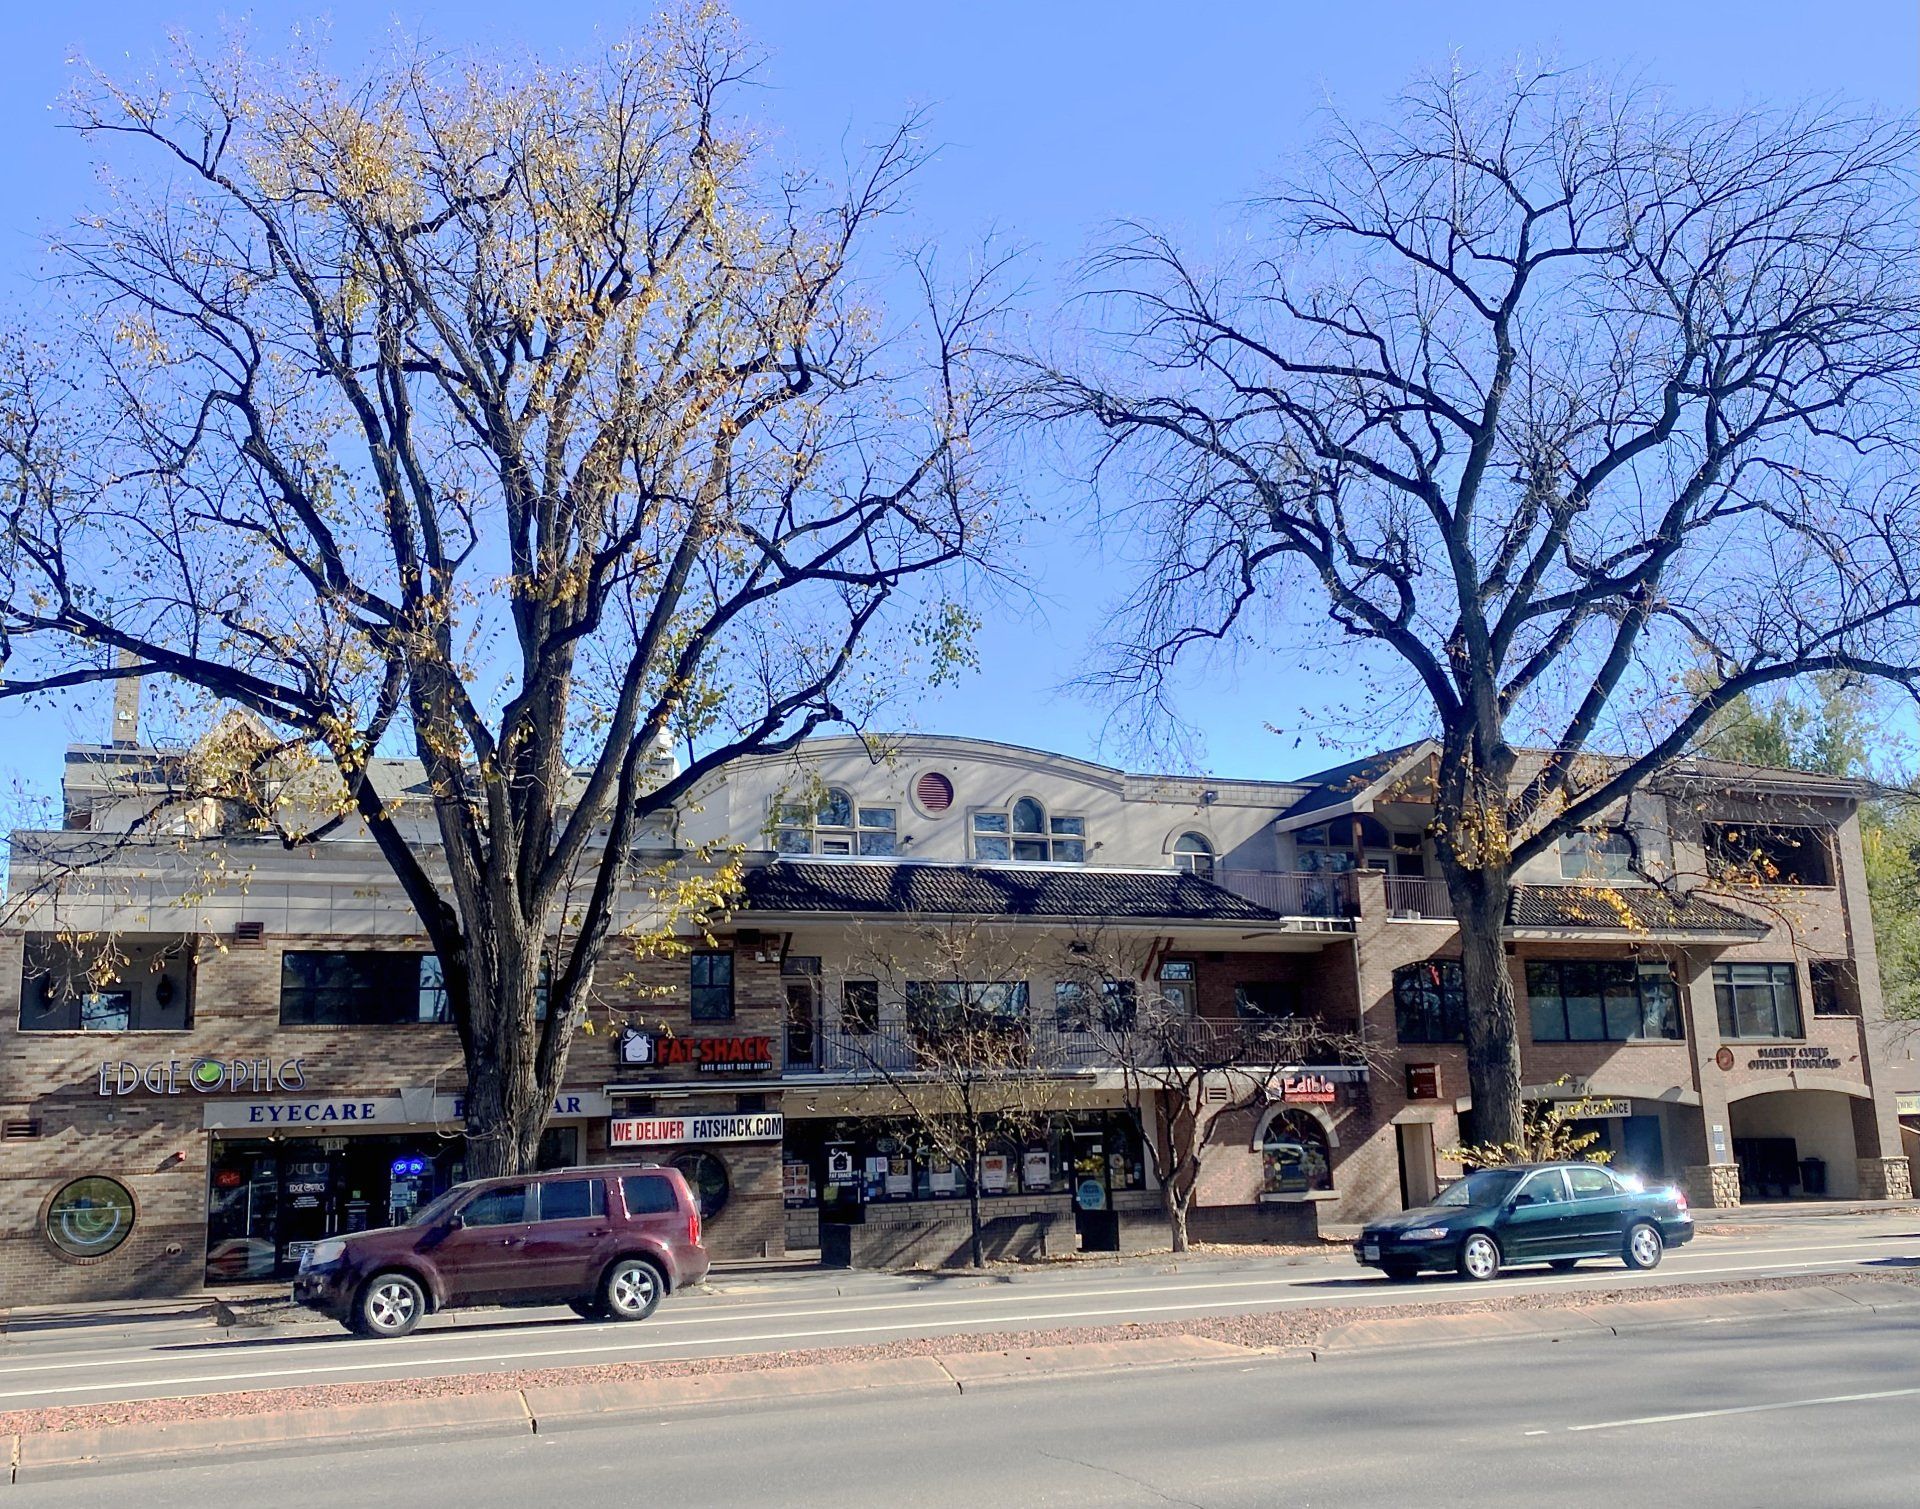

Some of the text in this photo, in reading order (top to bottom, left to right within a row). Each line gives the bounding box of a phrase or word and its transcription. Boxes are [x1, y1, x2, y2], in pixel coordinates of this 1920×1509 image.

[657, 1036, 773, 1063] FAT SHACK
[99, 1057, 306, 1096] EDGE OPTICS
[1284, 1075, 1335, 1093] Edible
[250, 1103, 375, 1123] EYECARE
[613, 1117, 782, 1142] WE DELIVER FATSHACK.COM
[394, 1162, 422, 1172] OPEN
